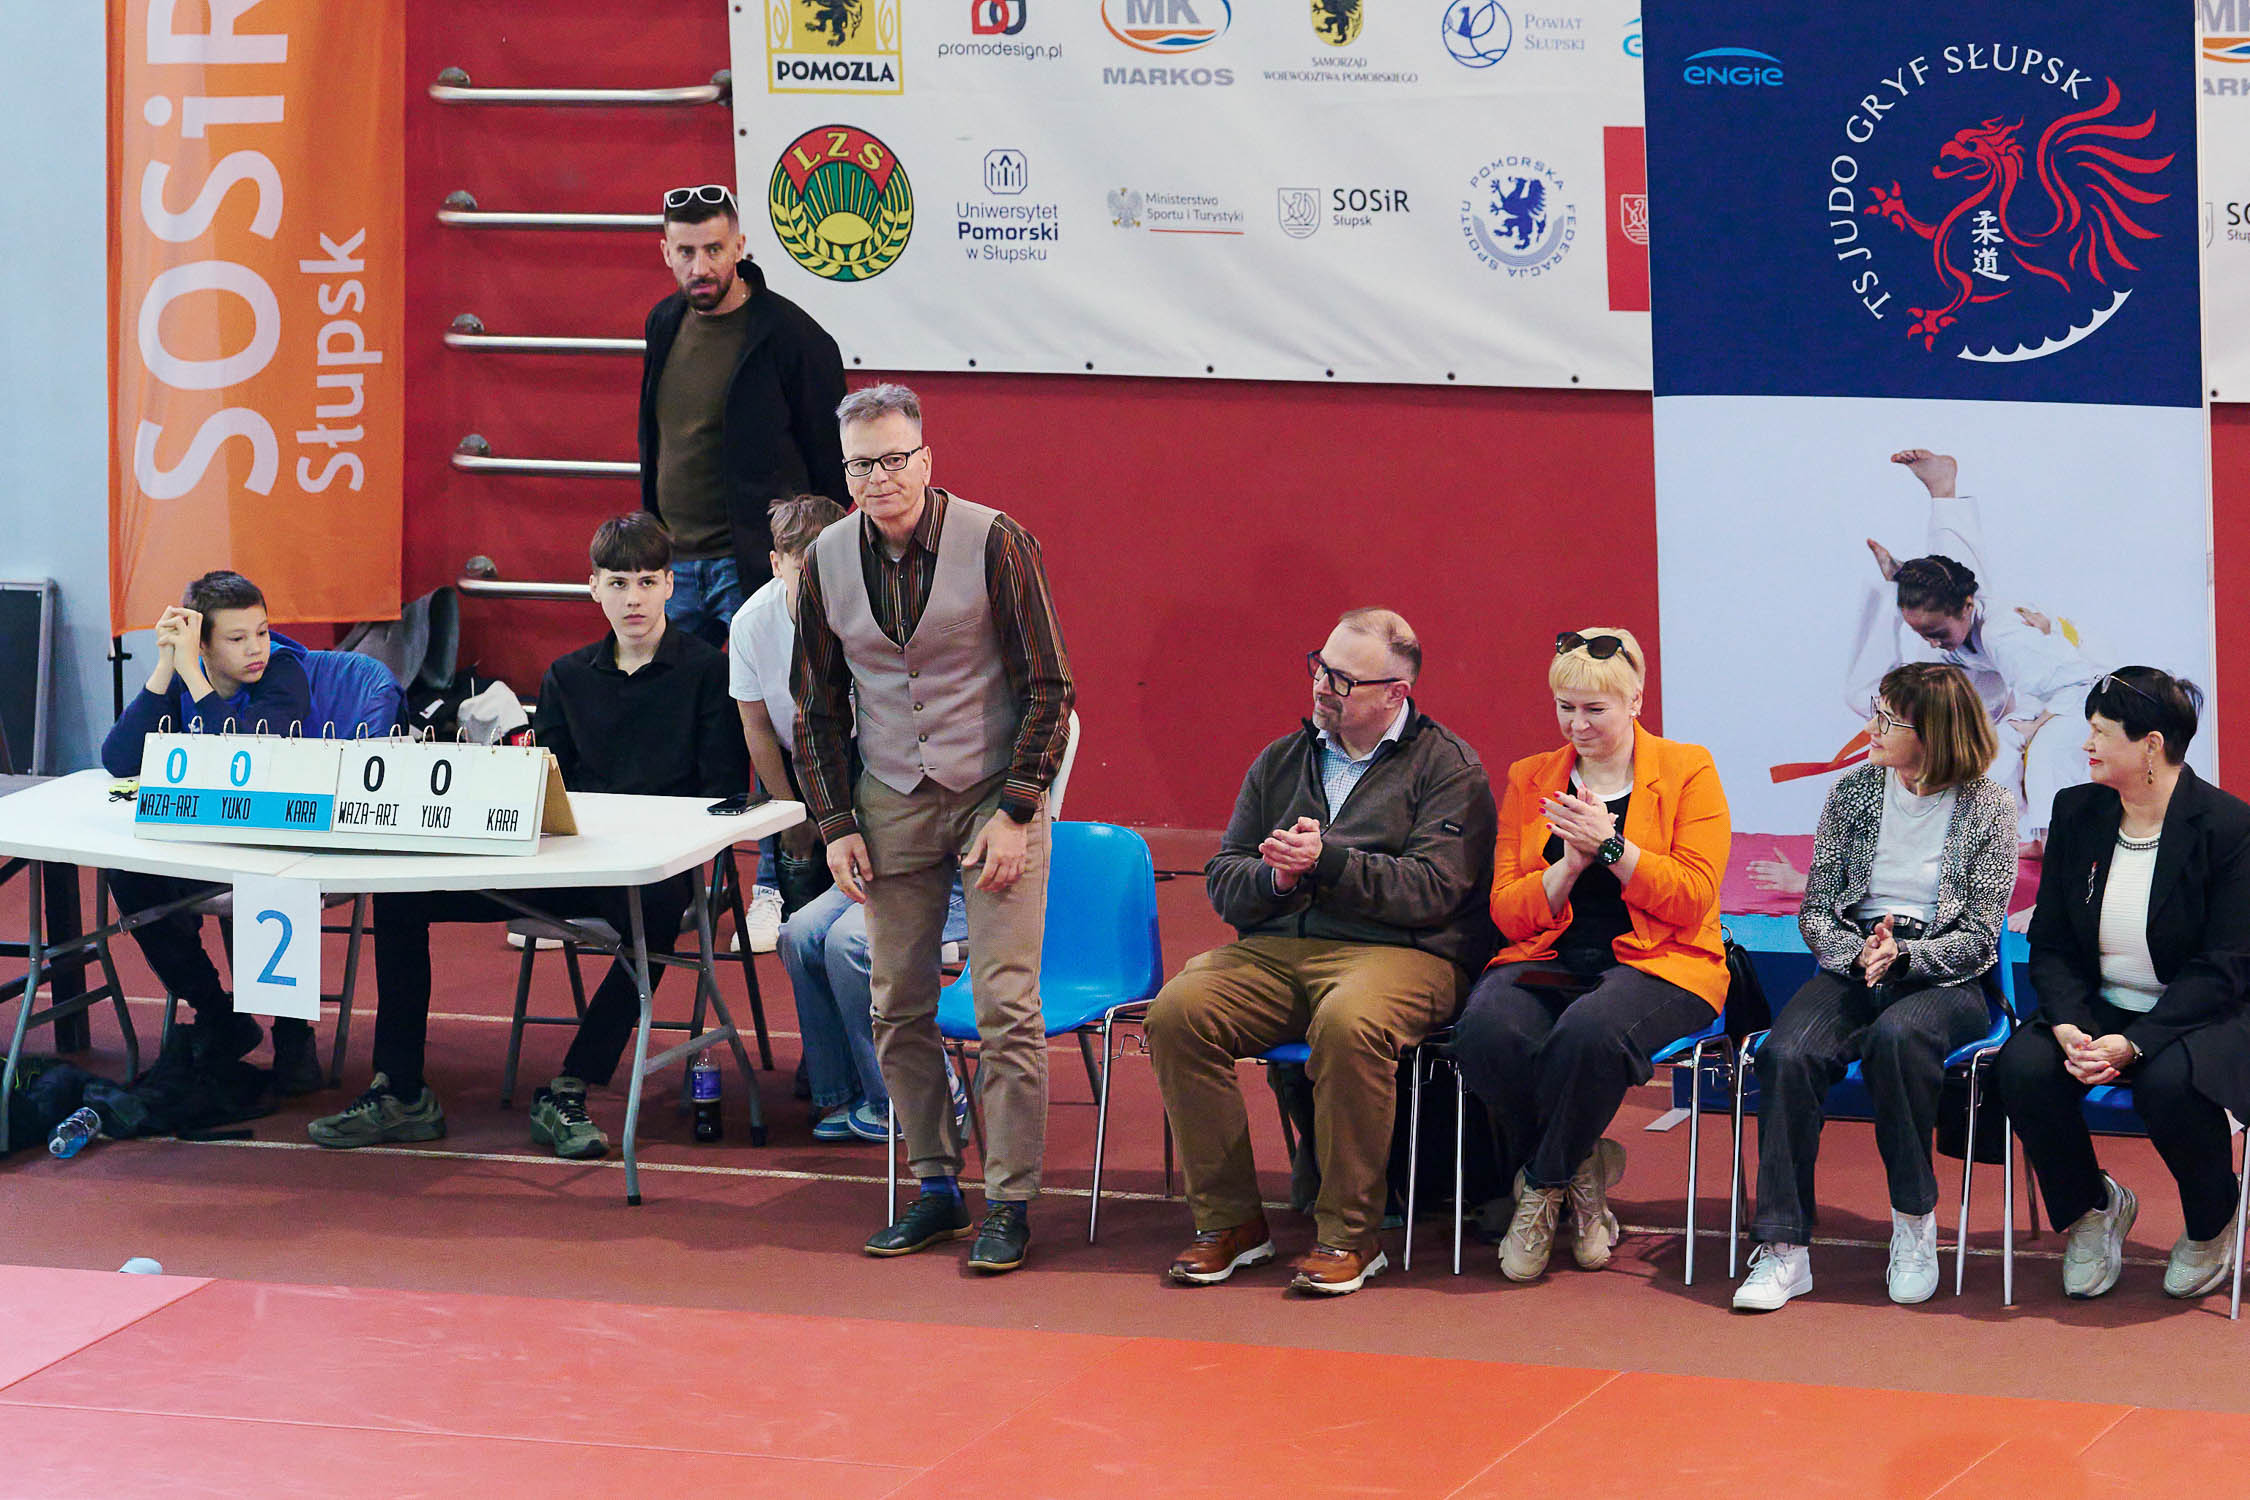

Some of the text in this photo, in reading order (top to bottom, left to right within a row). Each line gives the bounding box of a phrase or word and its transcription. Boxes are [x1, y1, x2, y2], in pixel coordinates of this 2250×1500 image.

[938, 42, 1062, 60] promodesign.pl
[777, 61, 895, 82] POMOZLA
[1103, 67, 1235, 86] MARKOS
[792, 132, 884, 172] LZS
[1828, 43, 2093, 320] TS JUDO GRYF SŁUPSK
[1146, 193, 1219, 206] Ministerstwo
[1333, 188, 1410, 212] SOSiR
[957, 201, 1058, 223] Uniwersytet
[1147, 208, 1184, 220] Sportu
[1194, 209, 1244, 223] Turystyki
[1333, 214, 1372, 228] Słupsk
[1461, 155, 1576, 278] POMORSKA FEDERACJA SPORTU
[958, 221, 1058, 240] Pomorski
[134, 0, 289, 499] SOSiR
[966, 244, 1047, 263] w Słupsku
[1971, 210, 2010, 281] 柔道
[296, 227, 383, 494] Słupsk
[139, 793, 317, 824] WAZA-ARI YUKO KARA
[338, 801, 519, 833] WAZA-ARI YUKO KARA
[256, 909, 297, 987] 2
